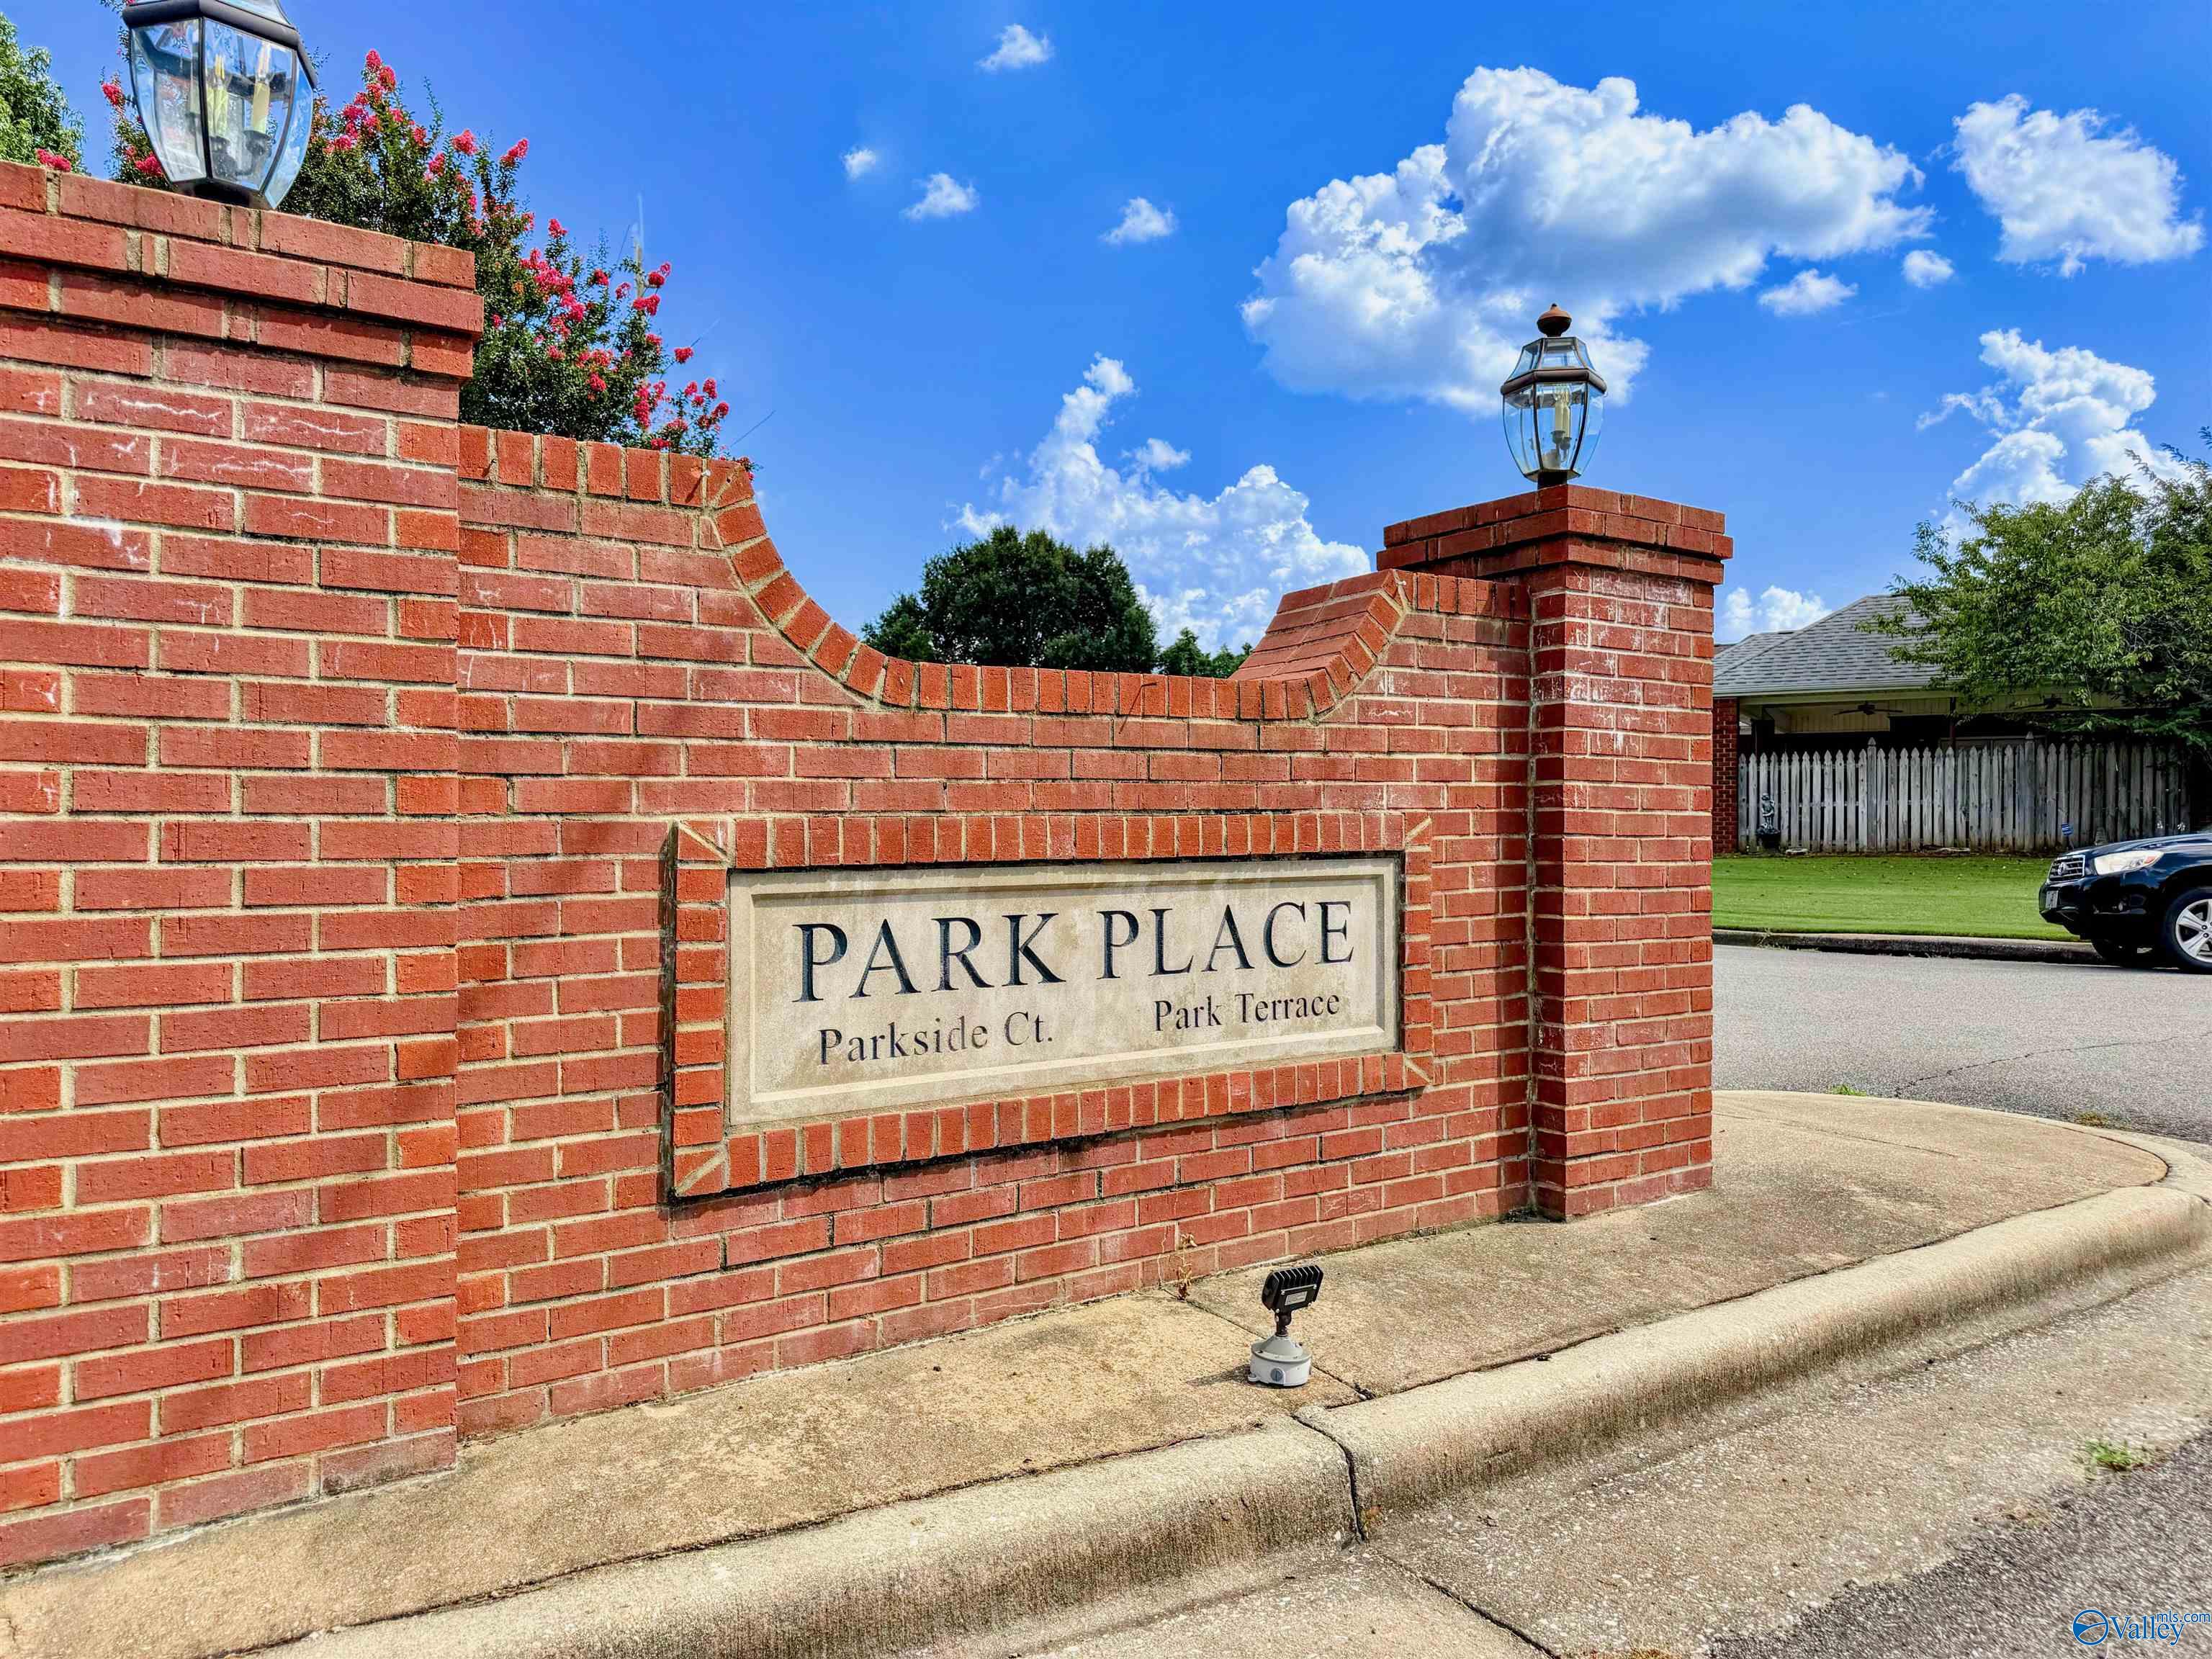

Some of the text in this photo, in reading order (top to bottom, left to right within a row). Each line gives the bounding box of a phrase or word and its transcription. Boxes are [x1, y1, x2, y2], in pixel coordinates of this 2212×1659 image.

[792, 901, 1354, 1003] PARK PLACE
[819, 1011, 1053, 1065] Parkside Ct.
[1154, 992, 1340, 1032] Park Terrace
